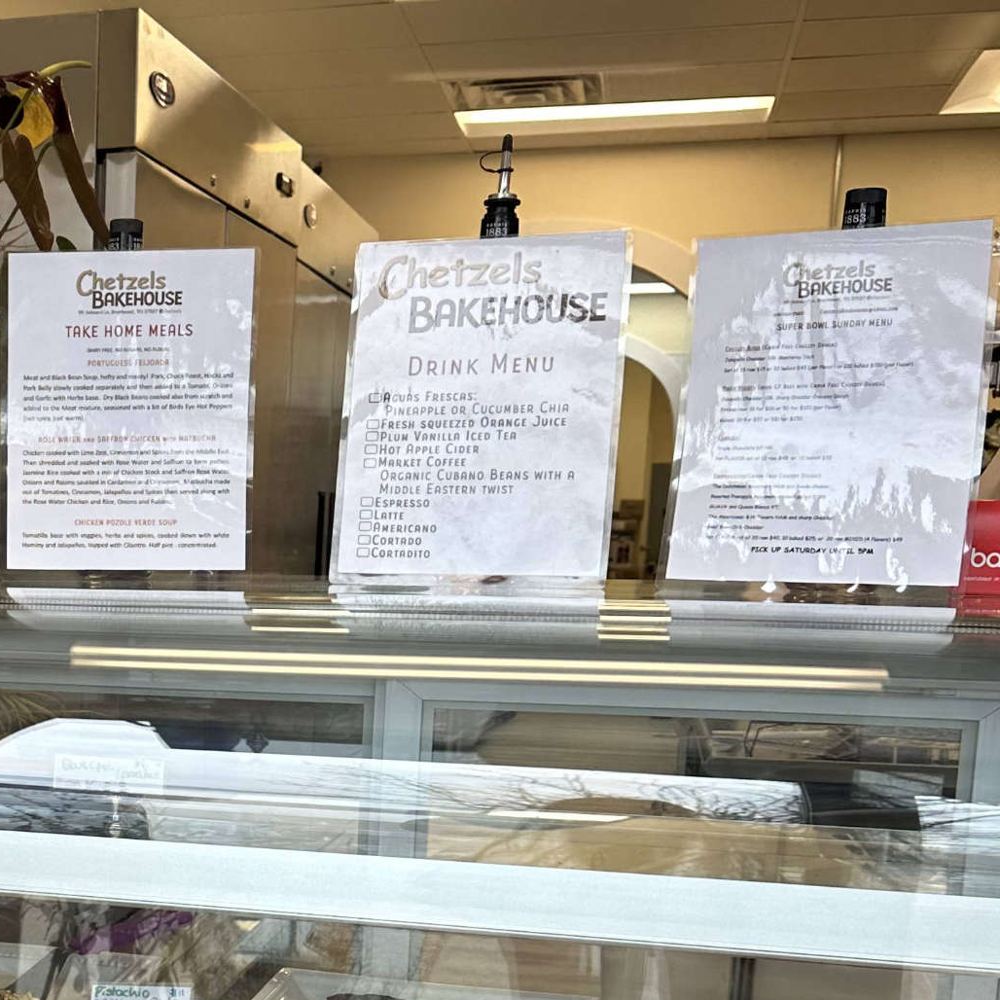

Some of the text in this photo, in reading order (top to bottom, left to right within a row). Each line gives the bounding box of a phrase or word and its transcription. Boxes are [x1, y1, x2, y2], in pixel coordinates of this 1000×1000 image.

[486, 228, 507, 237] 1883
[378, 251, 542, 300] Chetzels
[784, 260, 876, 287] Chetzels
[76, 270, 166, 296] Chetzels
[798, 278, 893, 298] BAKEHOUSE
[92, 290, 182, 309] BAKEHOUSE
[408, 291, 608, 334] BAKEHOUSE
[66, 323, 193, 338] TAKE HOME MEALS
[777, 318, 892, 331] SUPER BOWL SUNDAY MENU
[386, 404, 446, 416] PINEAPPLE
[473, 402, 534, 414] CUCUMBER
[540, 401, 569, 413] CHIA
[381, 416, 567, 430] FRESH SQUEEZED ORANGE JUICE
[414, 431, 460, 441] VANILLA
[466, 430, 490, 441] ICED
[497, 429, 517, 440] TEA
[379, 443, 479, 454] HOT APPLE CIDER
[379, 456, 467, 468] MARKET COFFEE
[380, 469, 575, 481] ORGANIC CUBANO BEANS WITH A
[379, 482, 514, 494] MIDDLE EASTERN TWIST
[375, 497, 430, 508] ESPRESSO
[374, 510, 404, 520] LATTE
[372, 534, 422, 545] CORTADO
[94, 986, 150, 998] Pistachio
